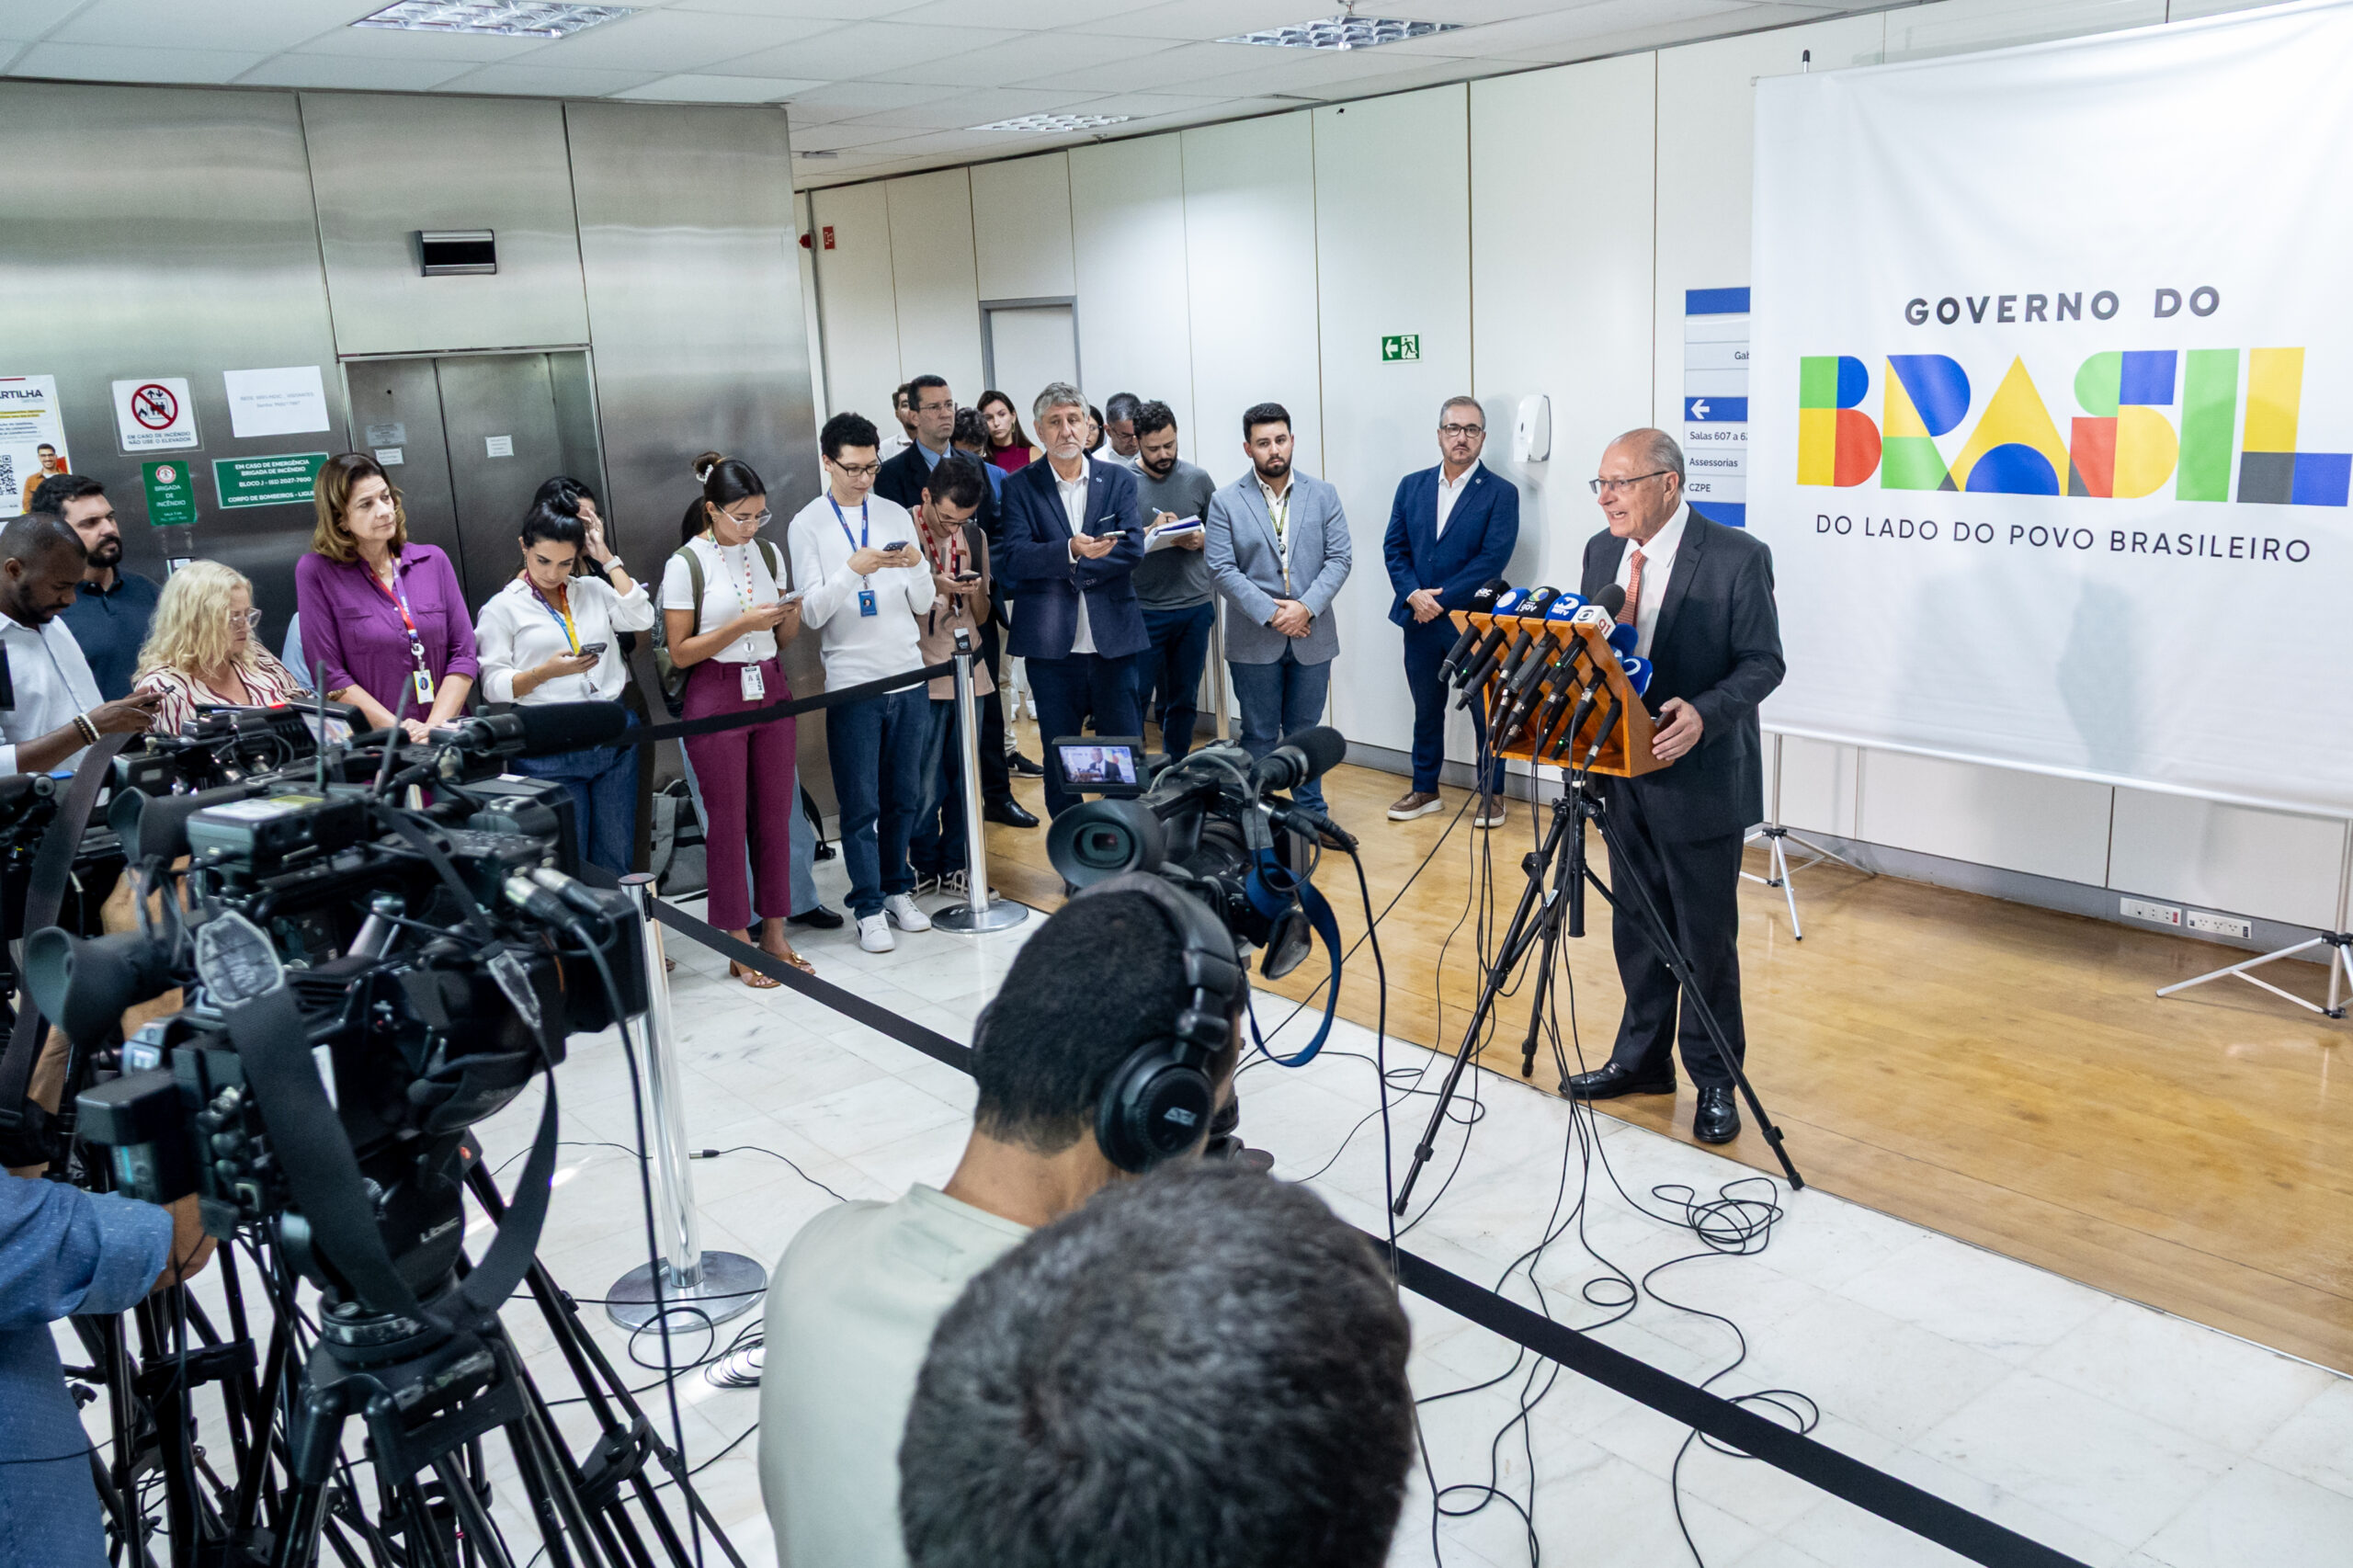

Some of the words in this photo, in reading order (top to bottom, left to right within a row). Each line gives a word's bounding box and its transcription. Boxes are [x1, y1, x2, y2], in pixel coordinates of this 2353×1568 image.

[1904, 290, 2120, 326] GOVERNO
[2154, 286, 2220, 318] DO
[0, 390, 43, 399] RTILHA
[1796, 346, 2353, 507] BRASIL
[1689, 431, 1712, 440] Salas
[1714, 431, 1731, 441] 607
[1733, 433, 1739, 441] a
[1688, 458, 1739, 468] Assessorias
[1688, 483, 1711, 493] CZPE
[1816, 515, 1852, 536] DO
[1865, 517, 1938, 540] LADO
[1953, 522, 1995, 544] DO
[2009, 525, 2094, 551] POVO
[2109, 530, 2311, 563] BRASILEIRO
